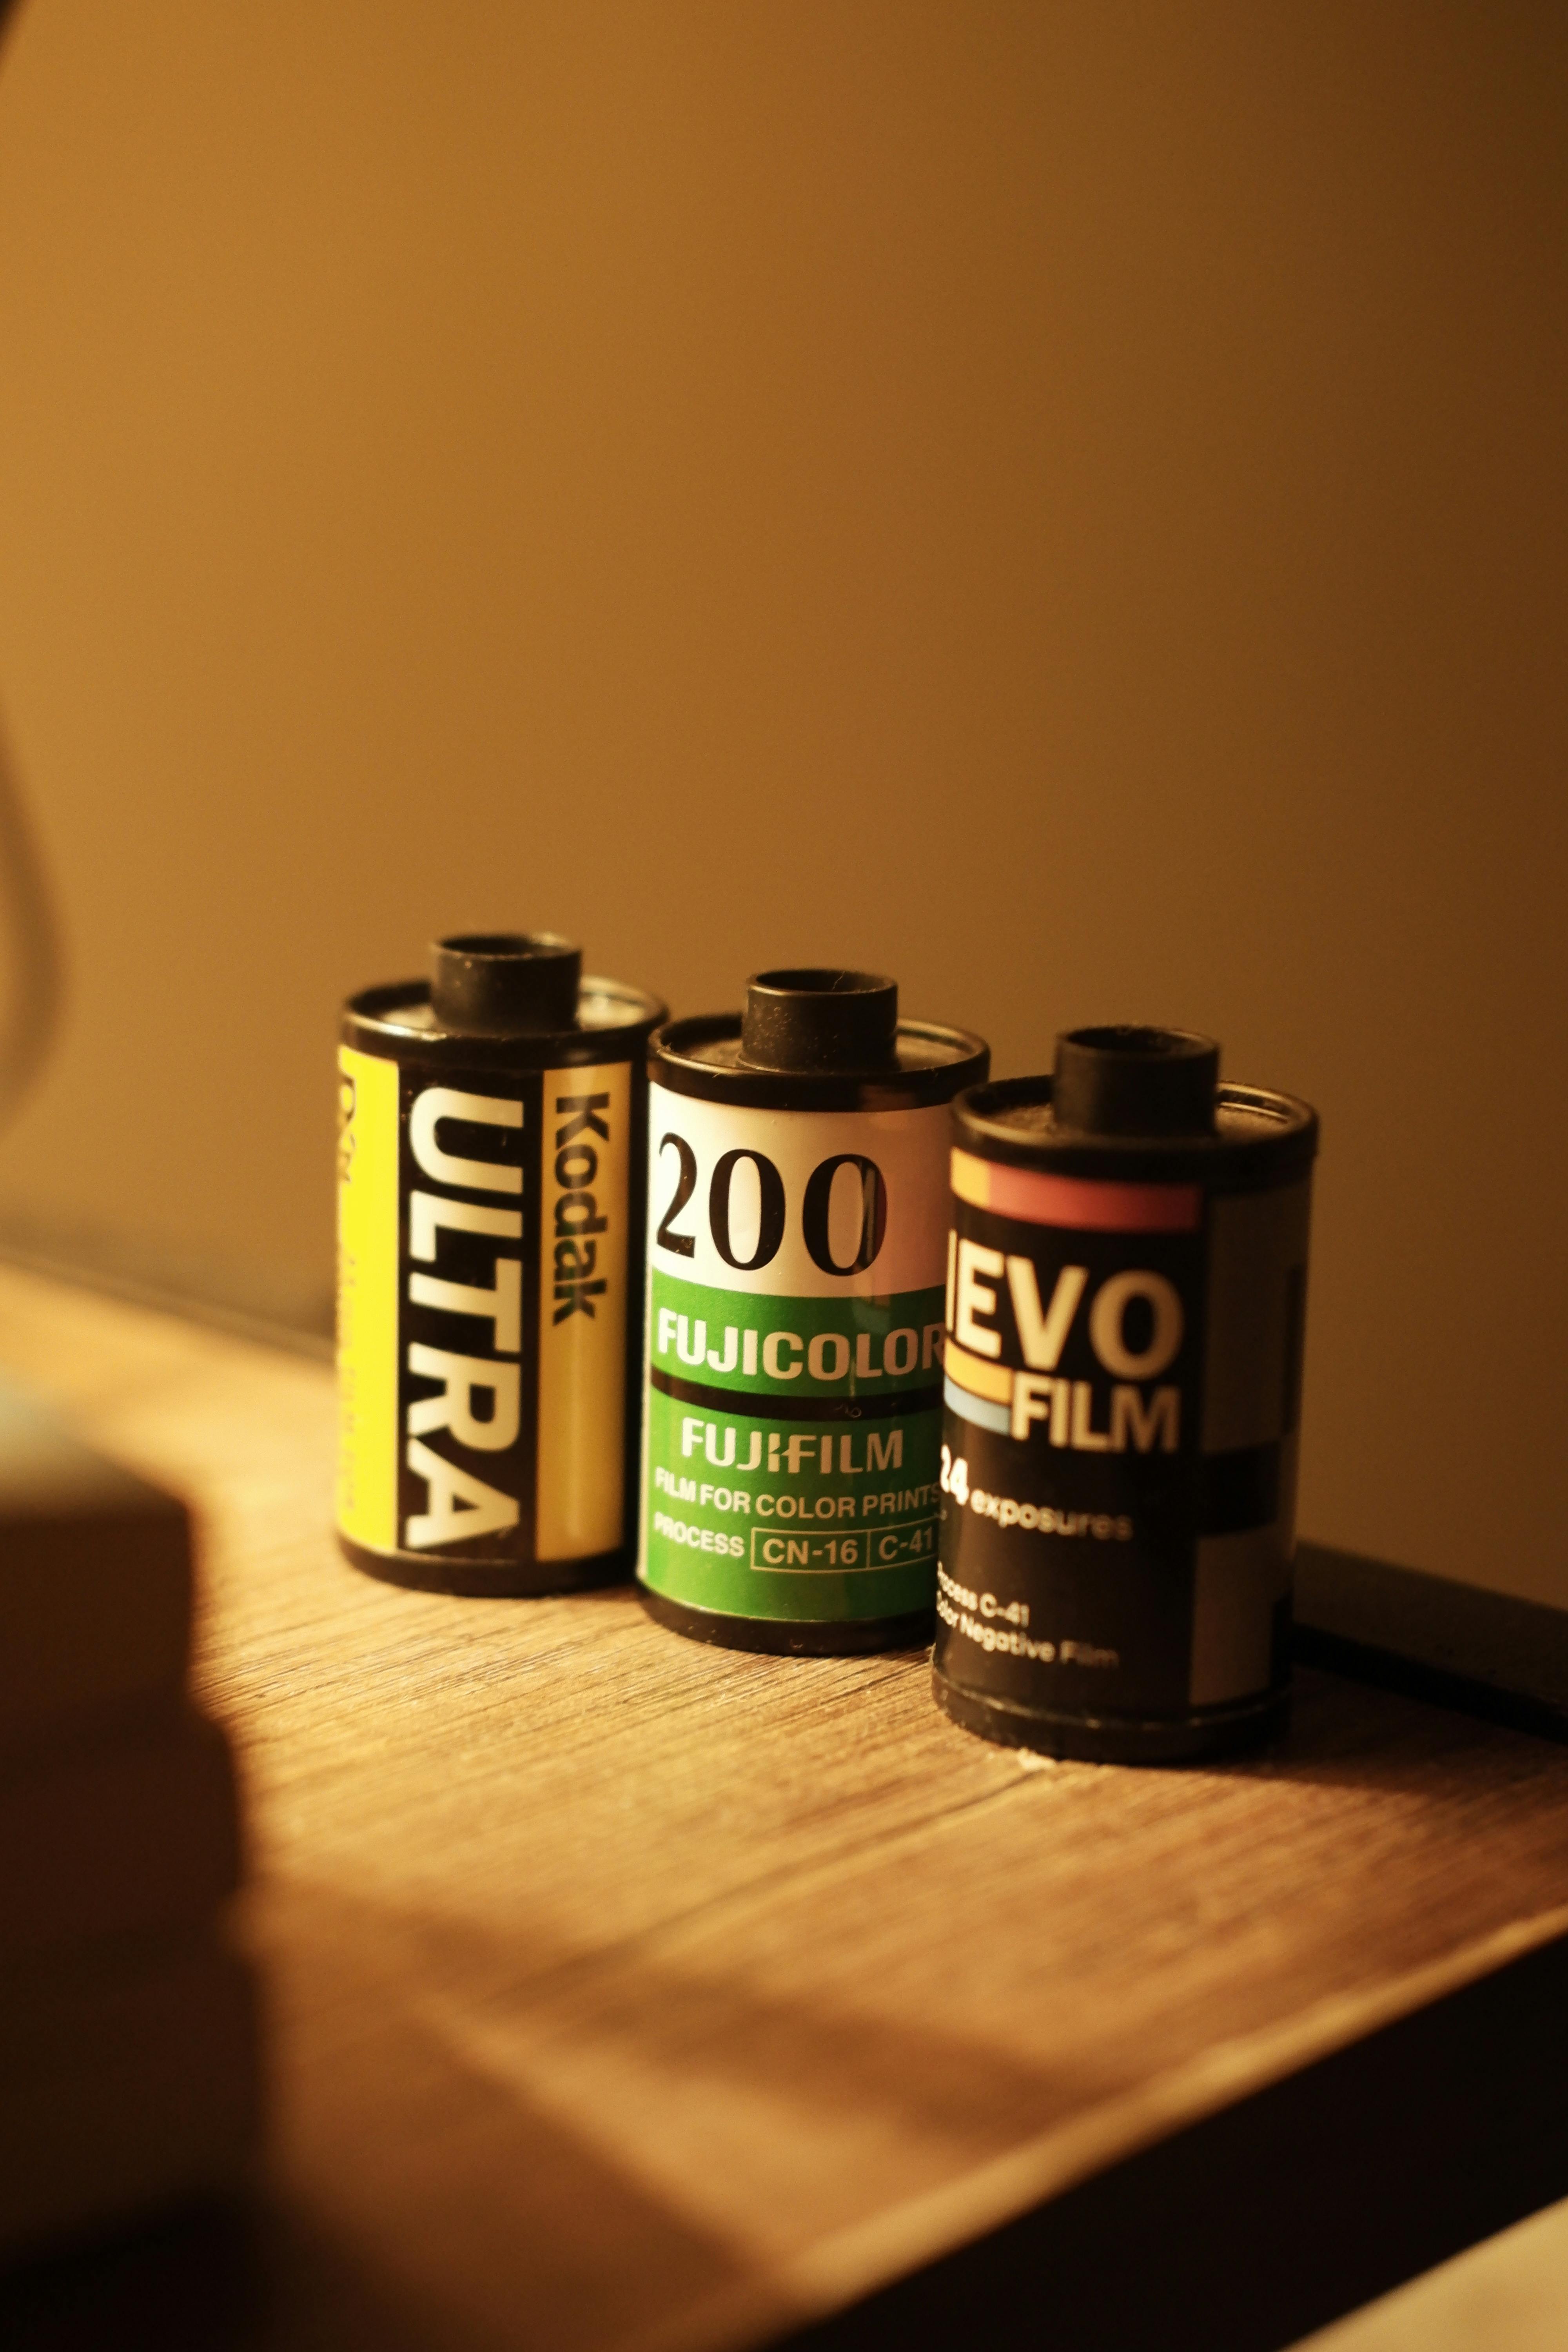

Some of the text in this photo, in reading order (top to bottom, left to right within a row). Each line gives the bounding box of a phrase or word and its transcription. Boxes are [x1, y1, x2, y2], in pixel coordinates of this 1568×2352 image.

[553, 1092, 610, 1327] Kodak
[657, 1132, 887, 1276] 200
[406, 1087, 524, 1549] ULTRA
[945, 1229, 1183, 1381] EVO
[658, 1307, 945, 1381] FUJICOLOR
[682, 1416, 903, 1474] FUJIFILM
[1010, 1371, 1180, 1454] FILM
[655, 1466, 940, 1519] FILM FOR COLOR PRINTS
[971, 1489, 1133, 1541] exposures
[654, 1511, 933, 1565] PROCESS CN-16 C-41
[960, 1613, 1055, 1662] Negative
[980, 1593, 1029, 1628] C-41
